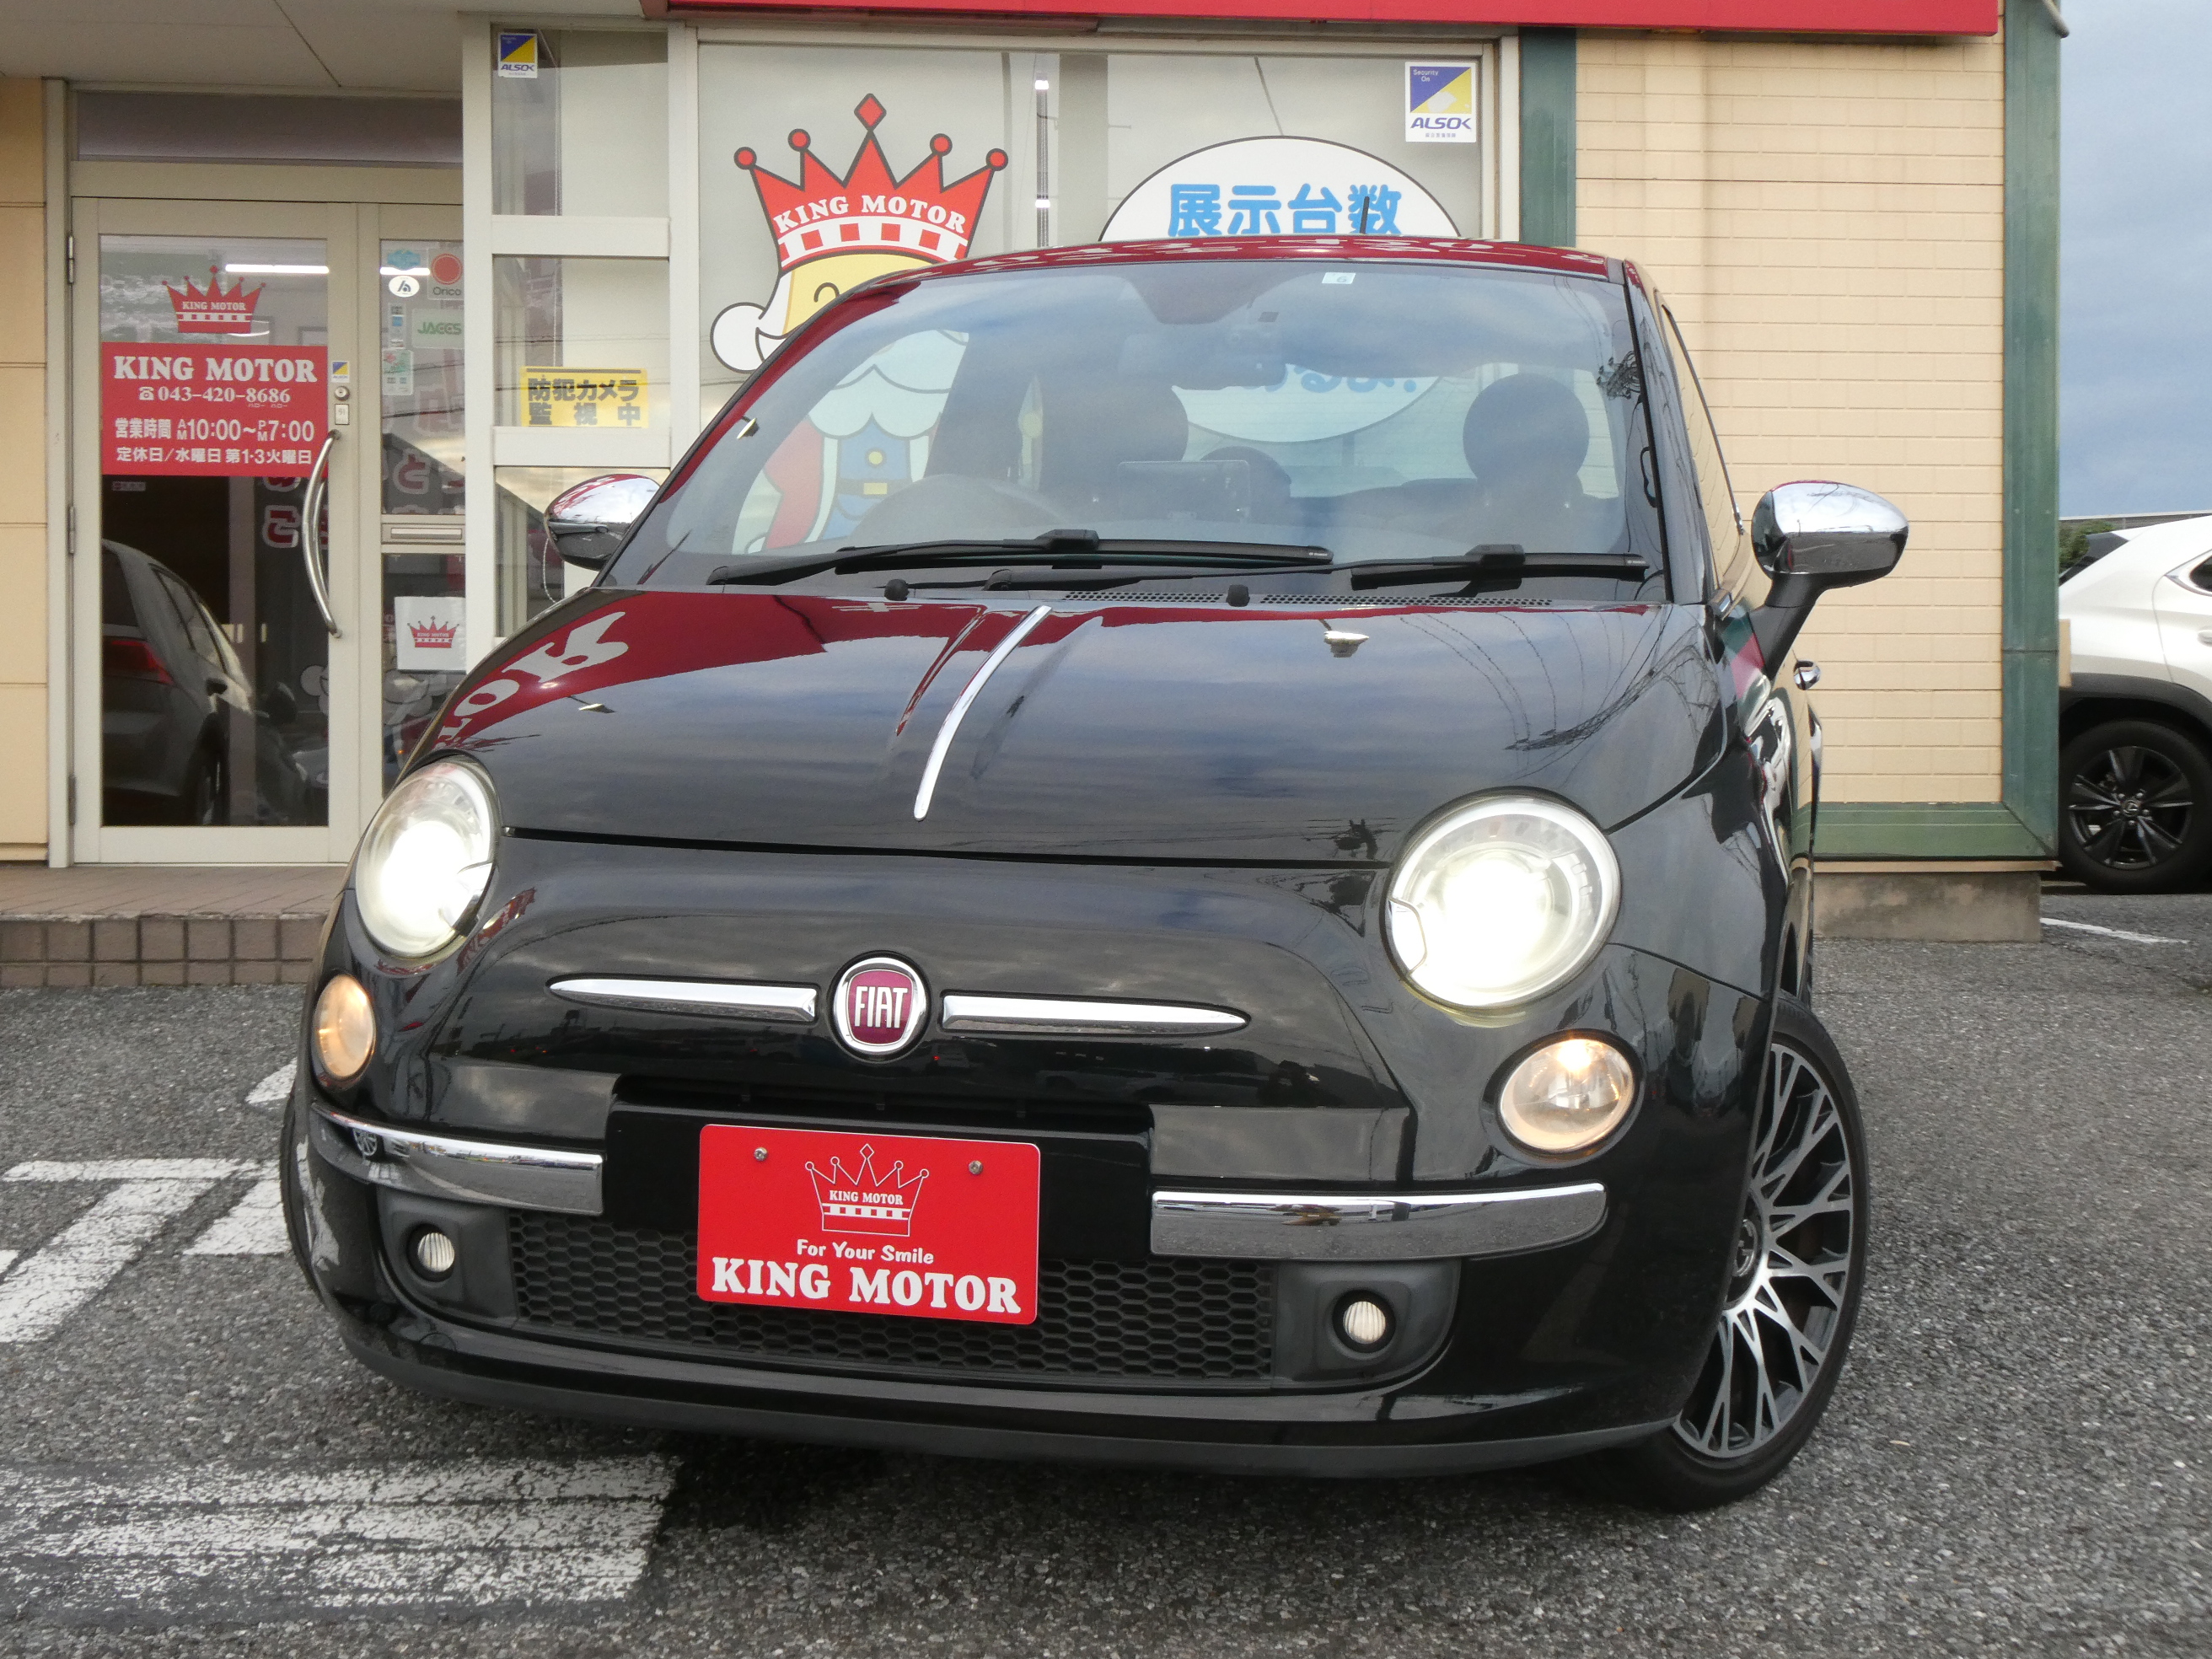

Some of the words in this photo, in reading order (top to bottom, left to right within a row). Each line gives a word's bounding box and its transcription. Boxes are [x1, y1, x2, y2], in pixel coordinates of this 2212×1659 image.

[1410, 117, 1472, 130] ALSOK
[773, 196, 849, 234] KING
[861, 195, 967, 234] MOTOR
[1167, 183, 1402, 237] 展示台数
[182, 301, 208, 310] KING
[211, 302, 246, 311] MOTOR
[417, 321, 462, 336] JACCS
[114, 356, 195, 380] KING
[206, 358, 318, 383] MOTOR
[528, 378, 640, 401] 防犯カメラ
[115, 418, 172, 439] 営業時間
[854, 985, 908, 1029] FIAT
[829, 1189, 859, 1203] KING
[862, 1192, 904, 1205] MOTOR
[797, 1239, 826, 1257] For
[832, 1242, 876, 1260] Your
[881, 1244, 935, 1264] Smile
[711, 1257, 830, 1299] KING
[849, 1267, 1021, 1313] MOTOR
